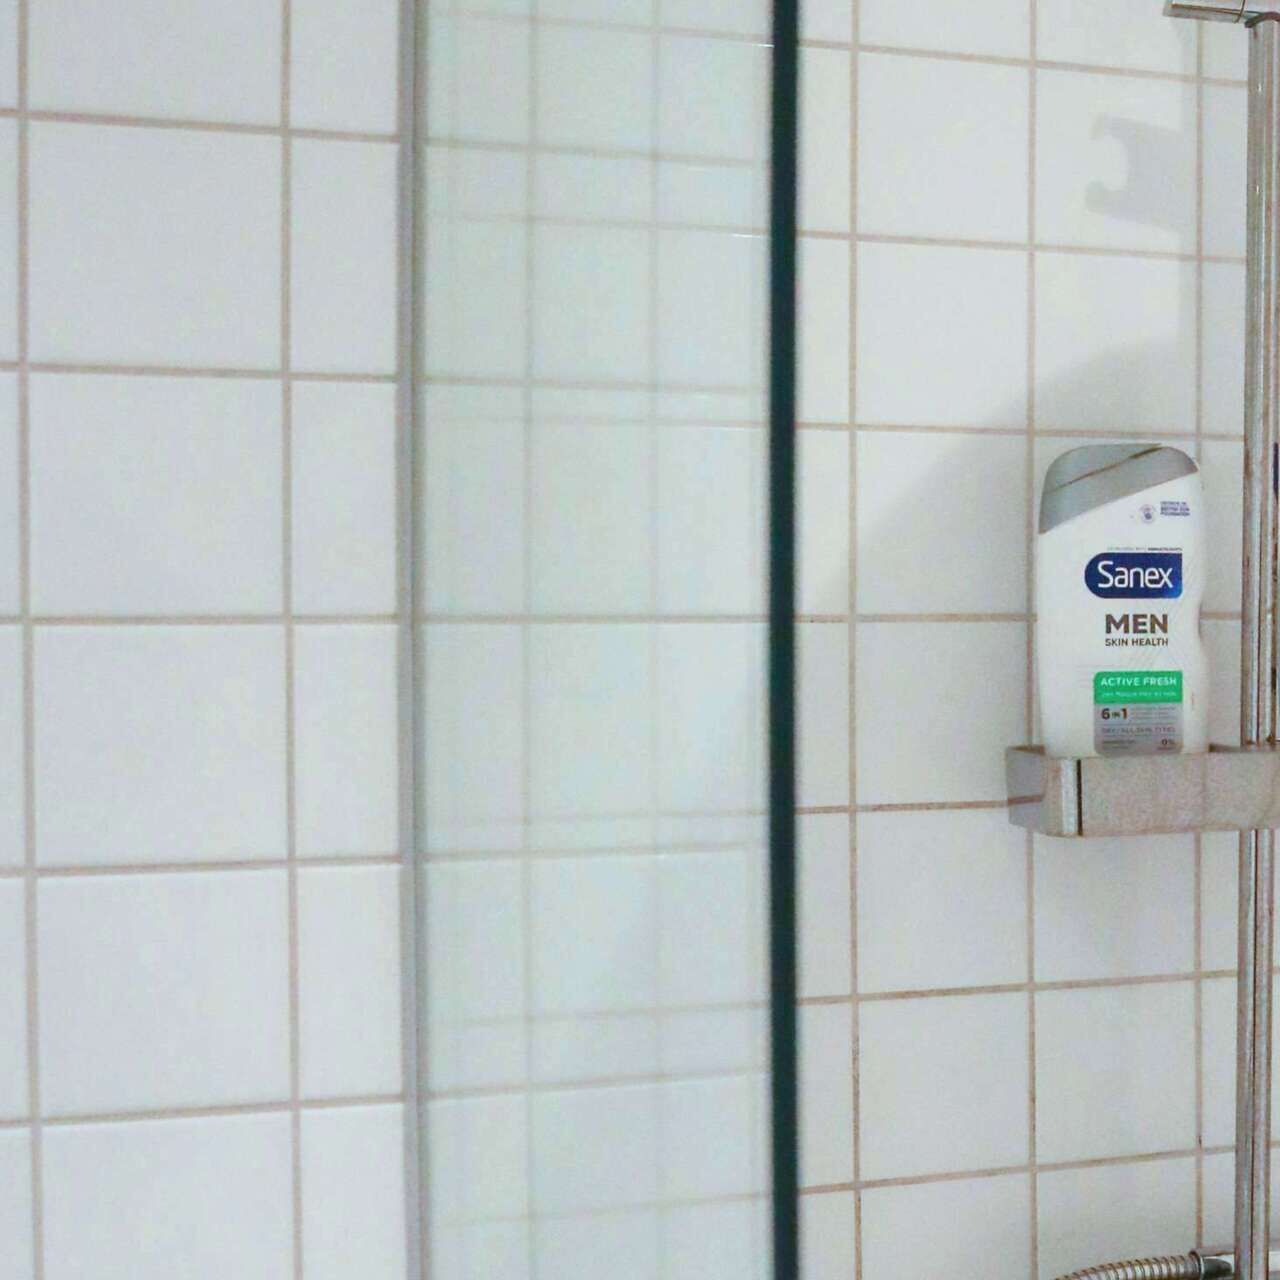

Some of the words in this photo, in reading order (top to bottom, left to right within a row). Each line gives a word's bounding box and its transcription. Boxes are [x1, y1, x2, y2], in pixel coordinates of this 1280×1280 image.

[1097, 560, 1173, 589] Sanex
[1105, 614, 1168, 634] MEN
[1105, 638, 1128, 647] SKIN
[1131, 638, 1168, 647] HEALTH
[1101, 677, 1140, 686] ACTIVE
[1143, 677, 1177, 686] FRESH
